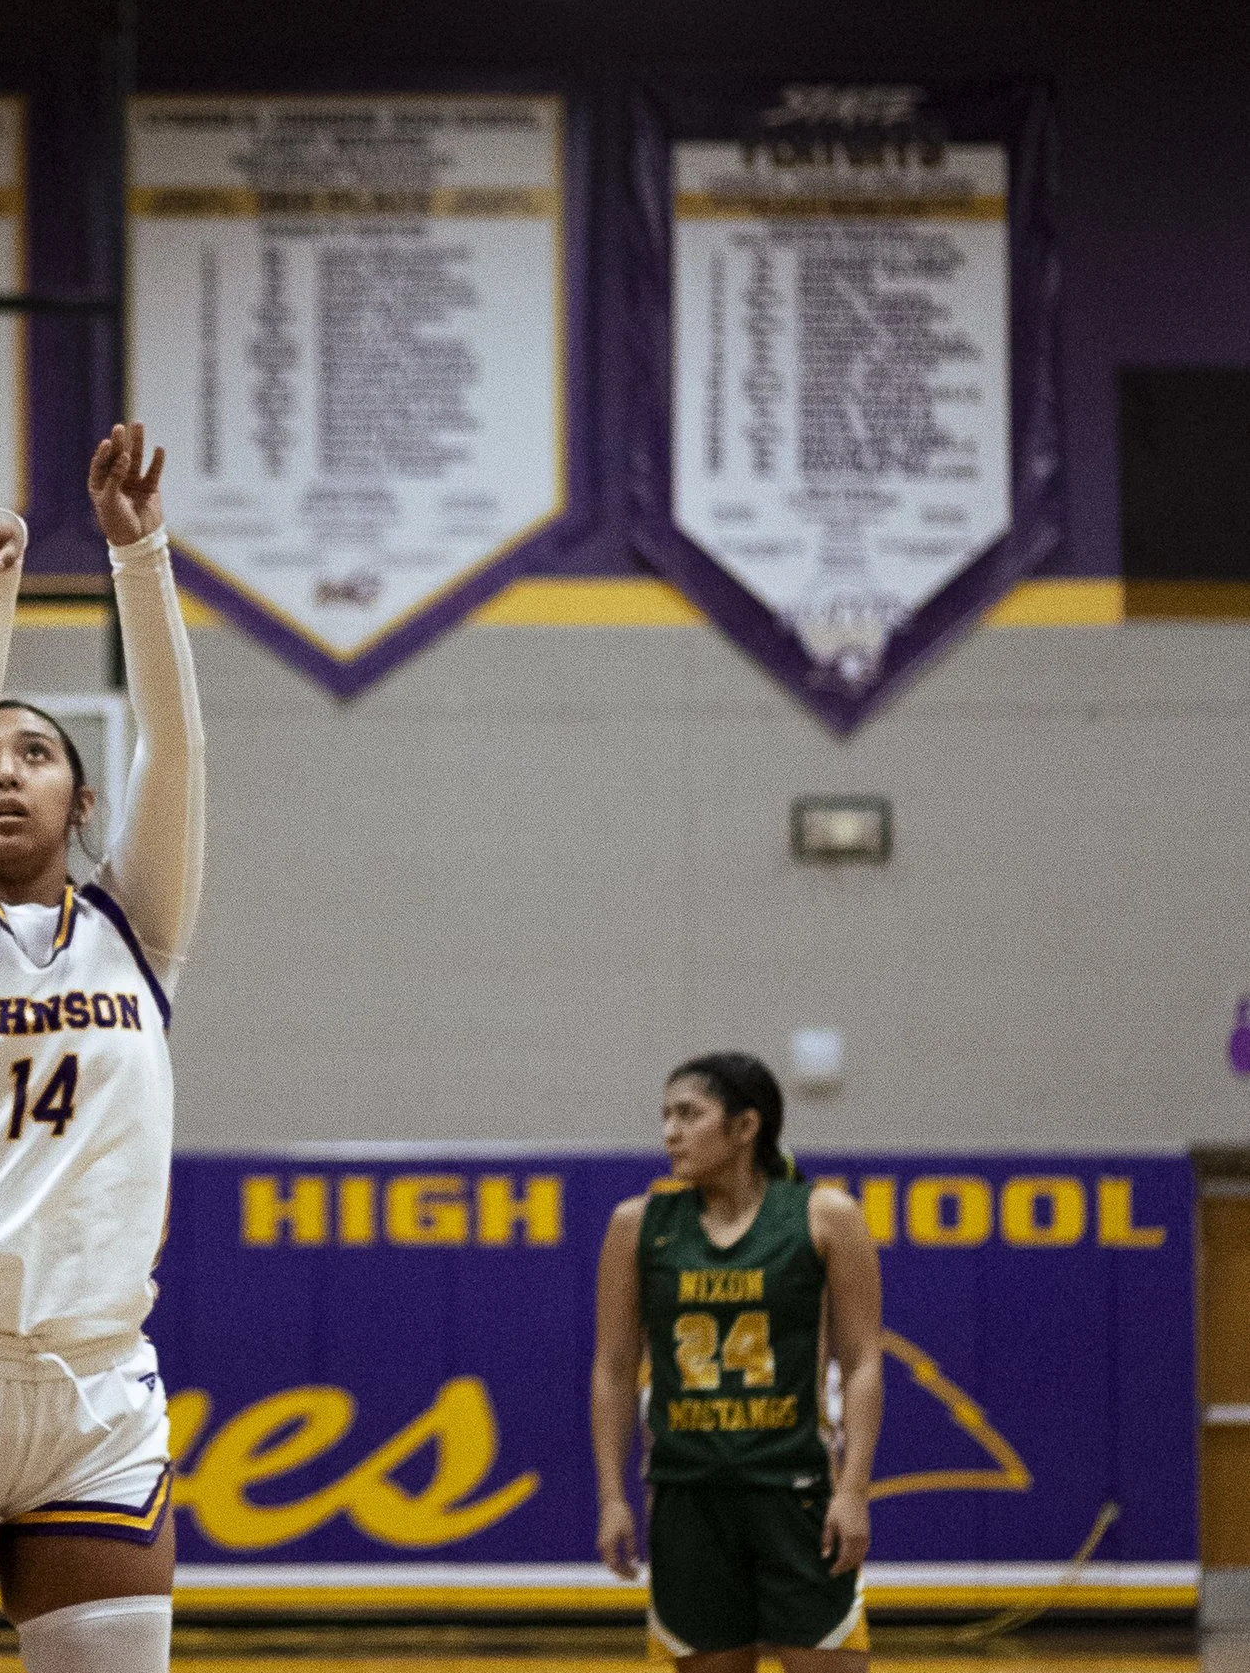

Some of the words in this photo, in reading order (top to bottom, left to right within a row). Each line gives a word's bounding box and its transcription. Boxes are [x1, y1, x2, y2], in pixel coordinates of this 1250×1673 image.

[6, 1052, 80, 1140] 14
[239, 1173, 566, 1248] HIGH
[677, 1268, 765, 1304] NIXON
[673, 1309, 777, 1391] 24
